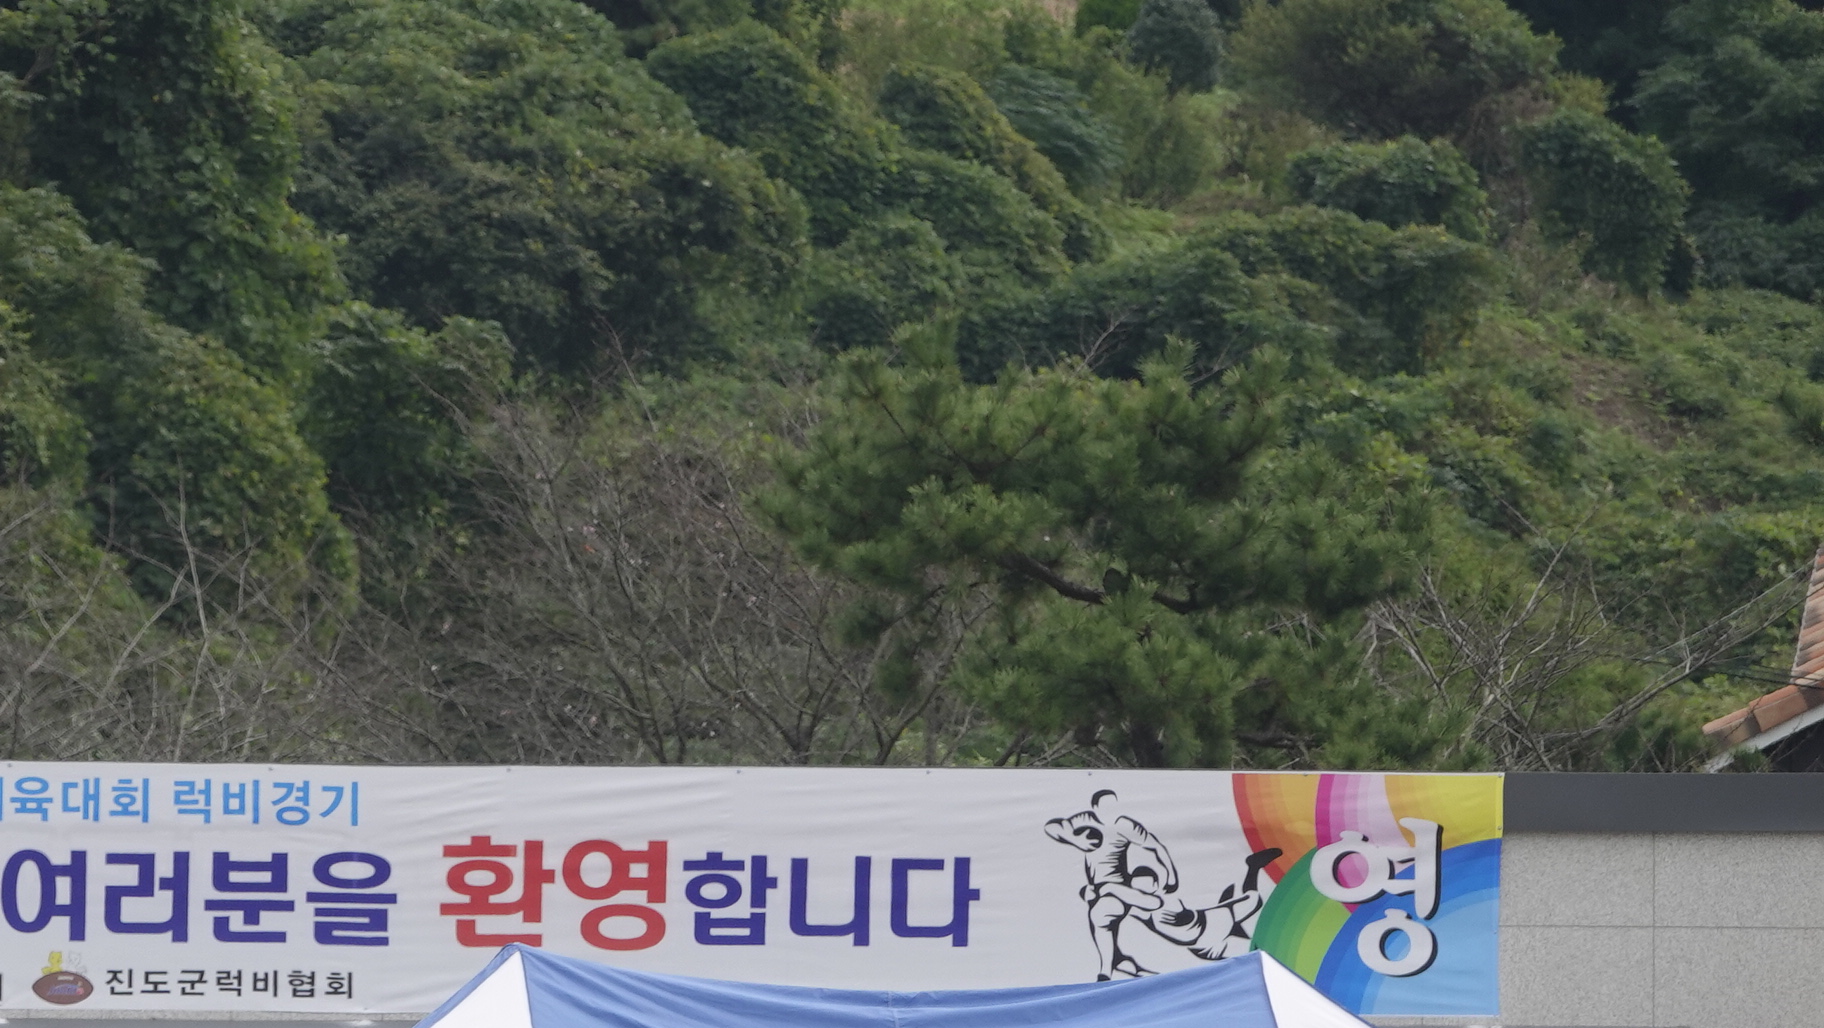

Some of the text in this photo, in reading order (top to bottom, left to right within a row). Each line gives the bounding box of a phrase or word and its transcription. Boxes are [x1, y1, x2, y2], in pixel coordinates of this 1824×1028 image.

[175, 779, 357, 827] 럭비경기
[1, 850, 397, 947] 여러분을
[439, 835, 980, 951] 환영합니다
[1310, 817, 1443, 978] 영
[105, 968, 354, 1000] 진도군럭비협회
